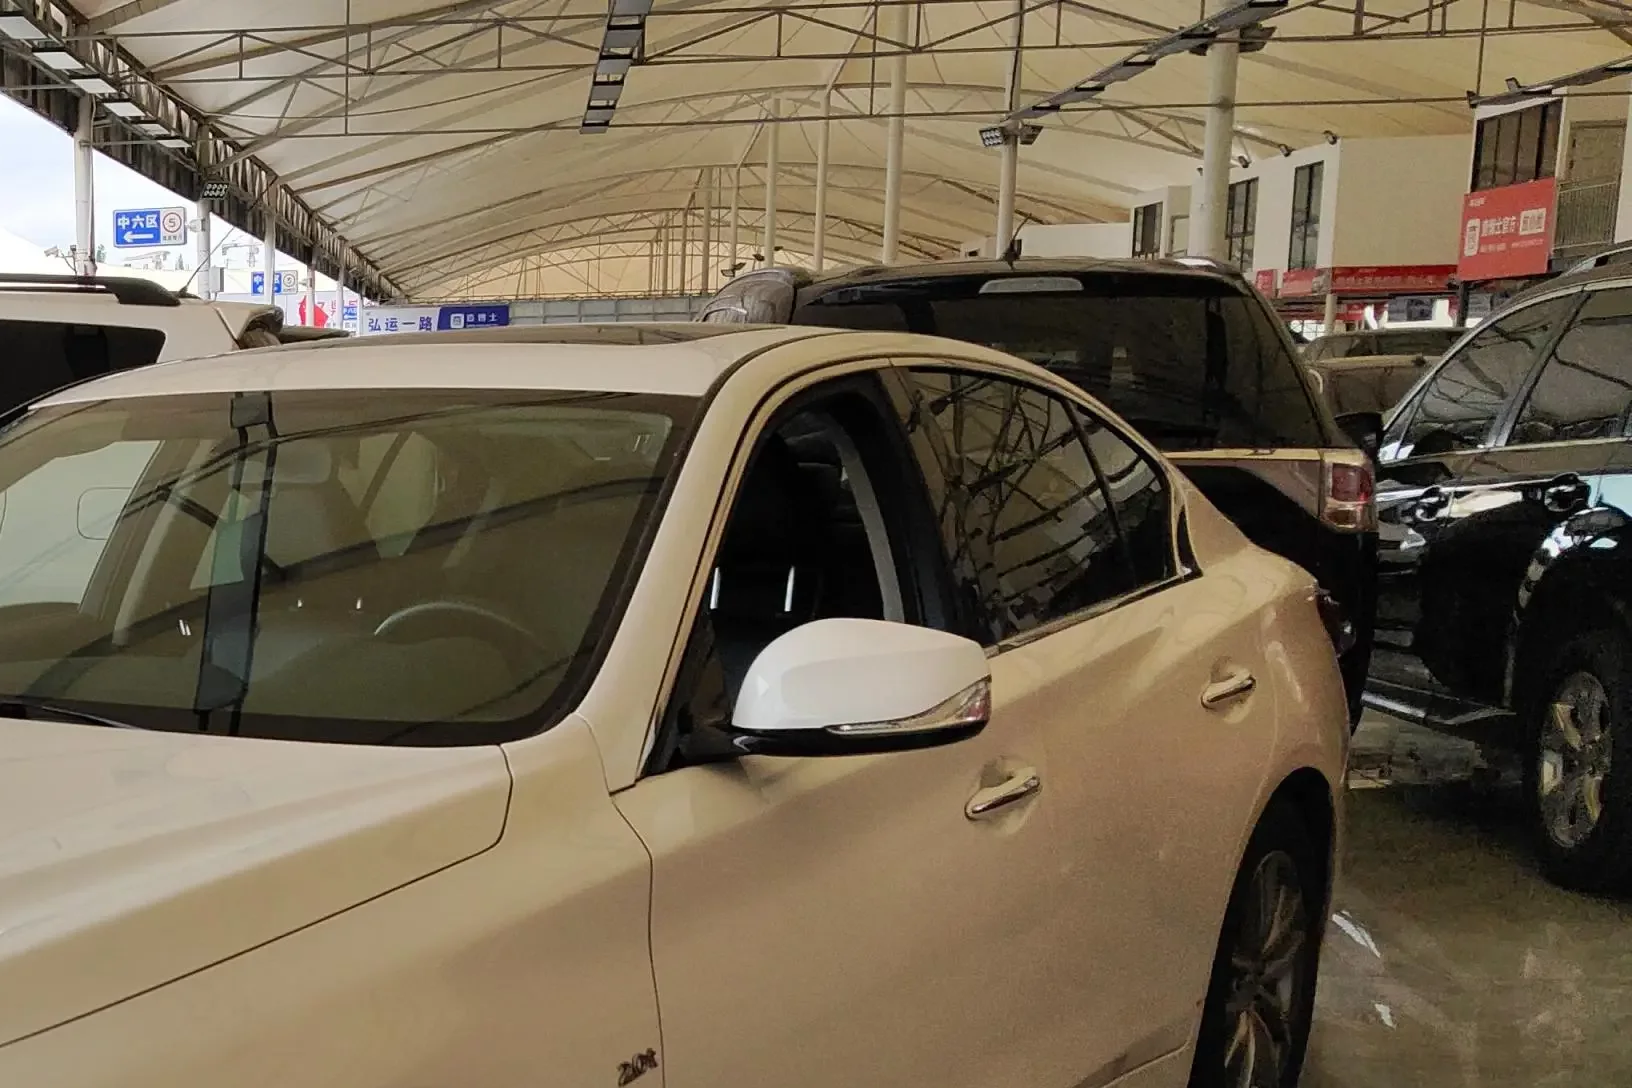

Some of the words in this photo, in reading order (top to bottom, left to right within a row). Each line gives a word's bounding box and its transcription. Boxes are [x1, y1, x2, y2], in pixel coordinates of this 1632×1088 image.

[118, 214, 158, 230] 中六区
[253, 274, 281, 286] 中区
[368, 316, 433, 332] 弘运一路
